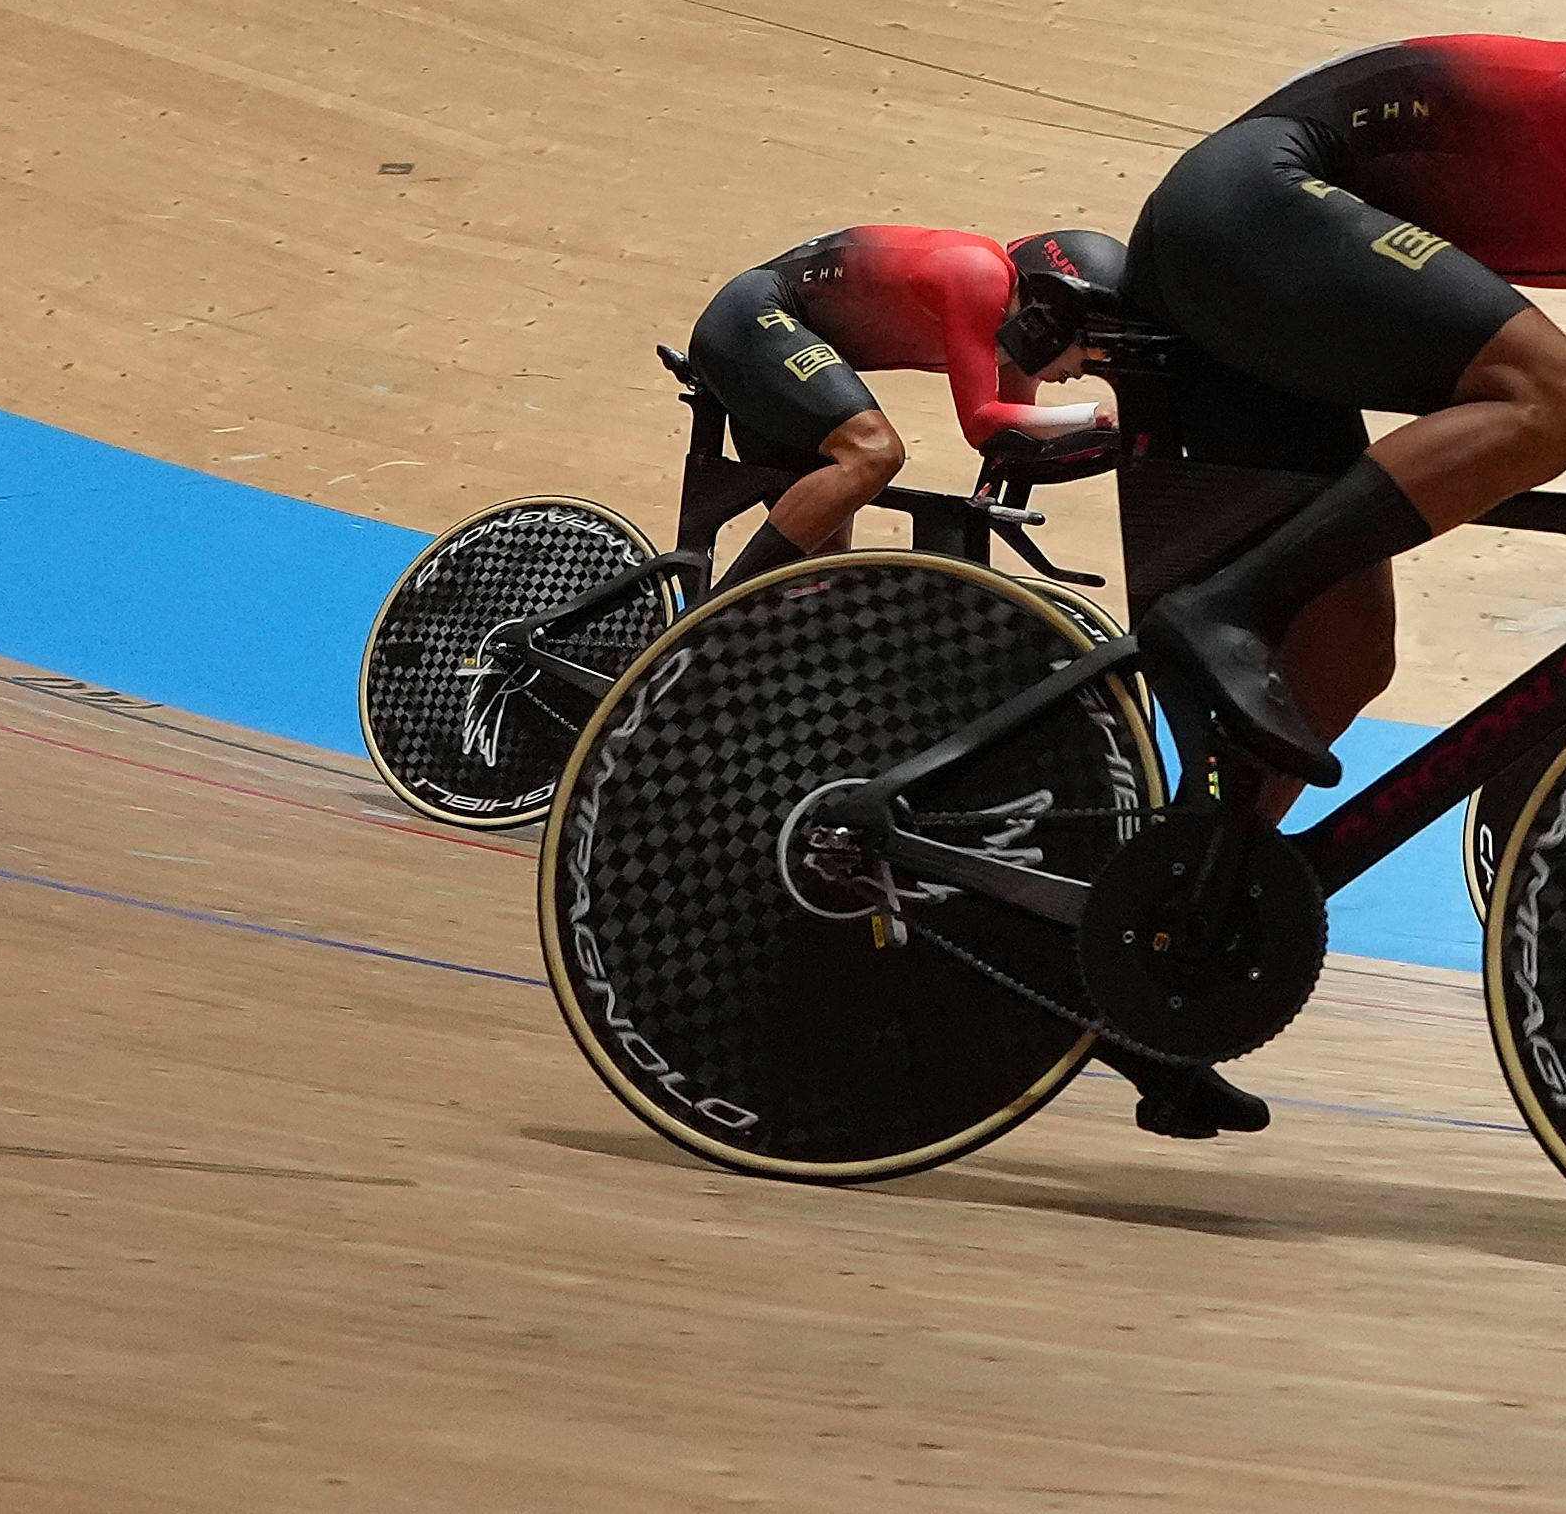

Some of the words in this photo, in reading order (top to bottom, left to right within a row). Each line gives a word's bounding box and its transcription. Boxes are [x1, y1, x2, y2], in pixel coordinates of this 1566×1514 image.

[1353, 100, 1430, 128] CHN
[802, 266, 844, 283] CHN
[569, 648, 759, 1129] CAMPAGNOLO
